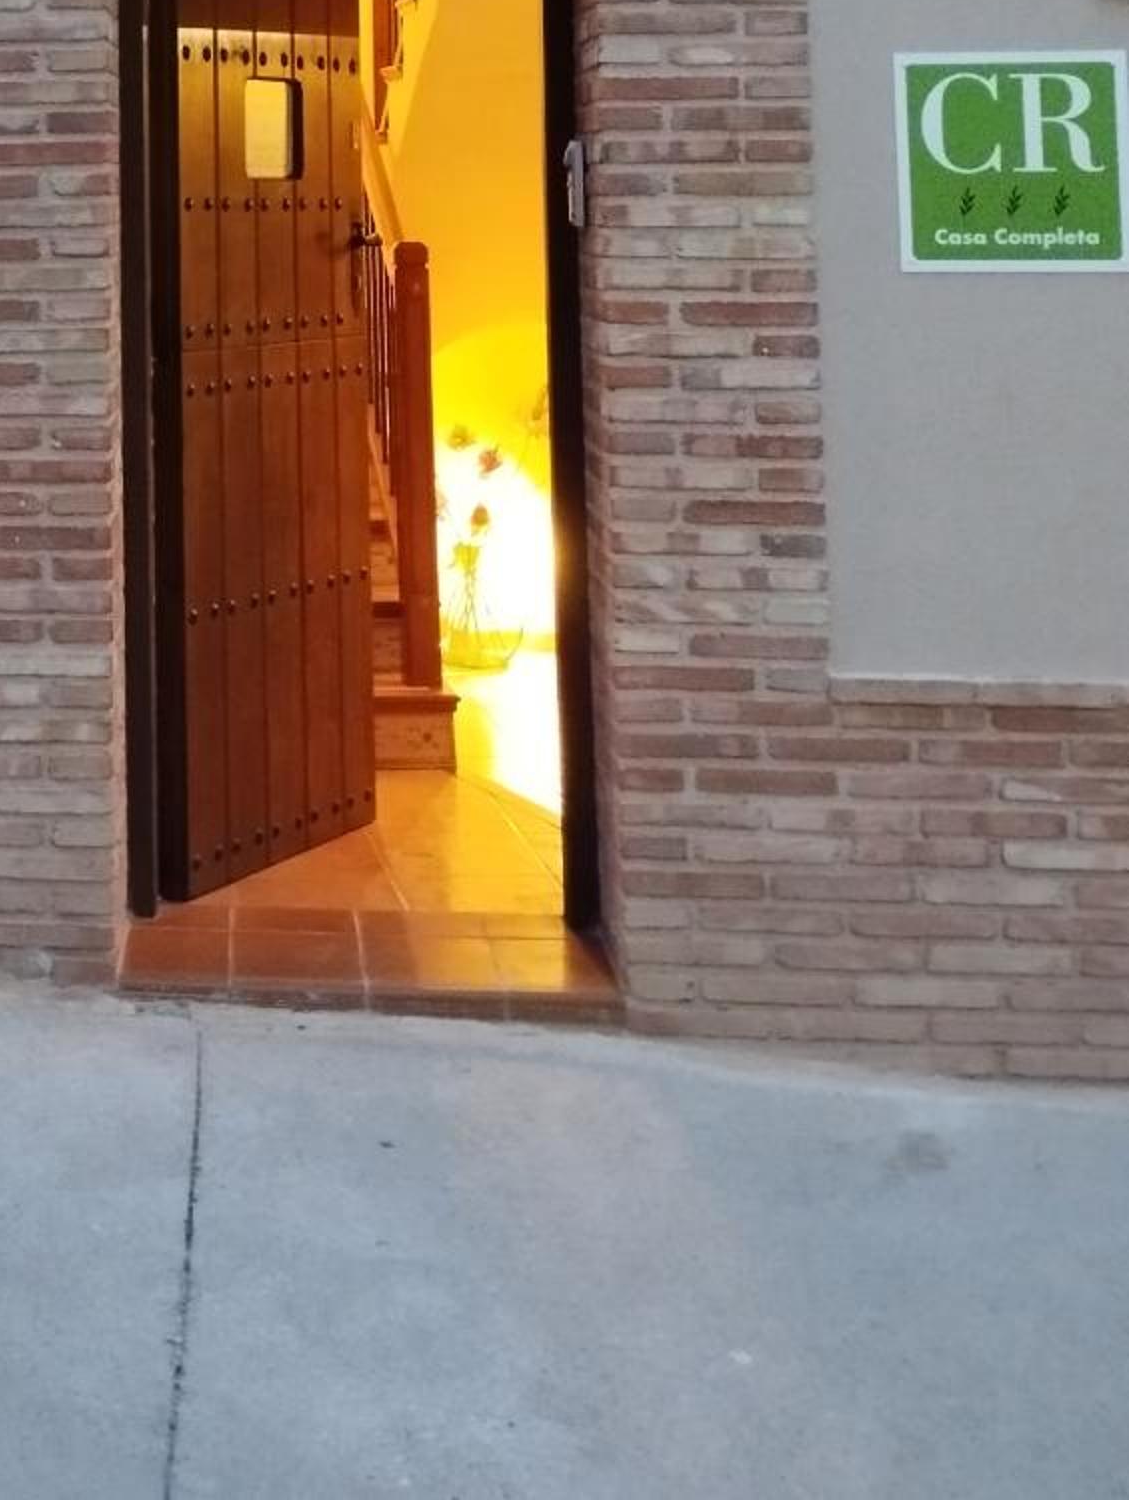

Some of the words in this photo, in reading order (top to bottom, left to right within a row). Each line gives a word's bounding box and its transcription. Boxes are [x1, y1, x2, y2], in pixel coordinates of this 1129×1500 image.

[921, 72, 1106, 174] CR
[934, 228, 987, 245] Casa
[994, 227, 1100, 249] Completa
